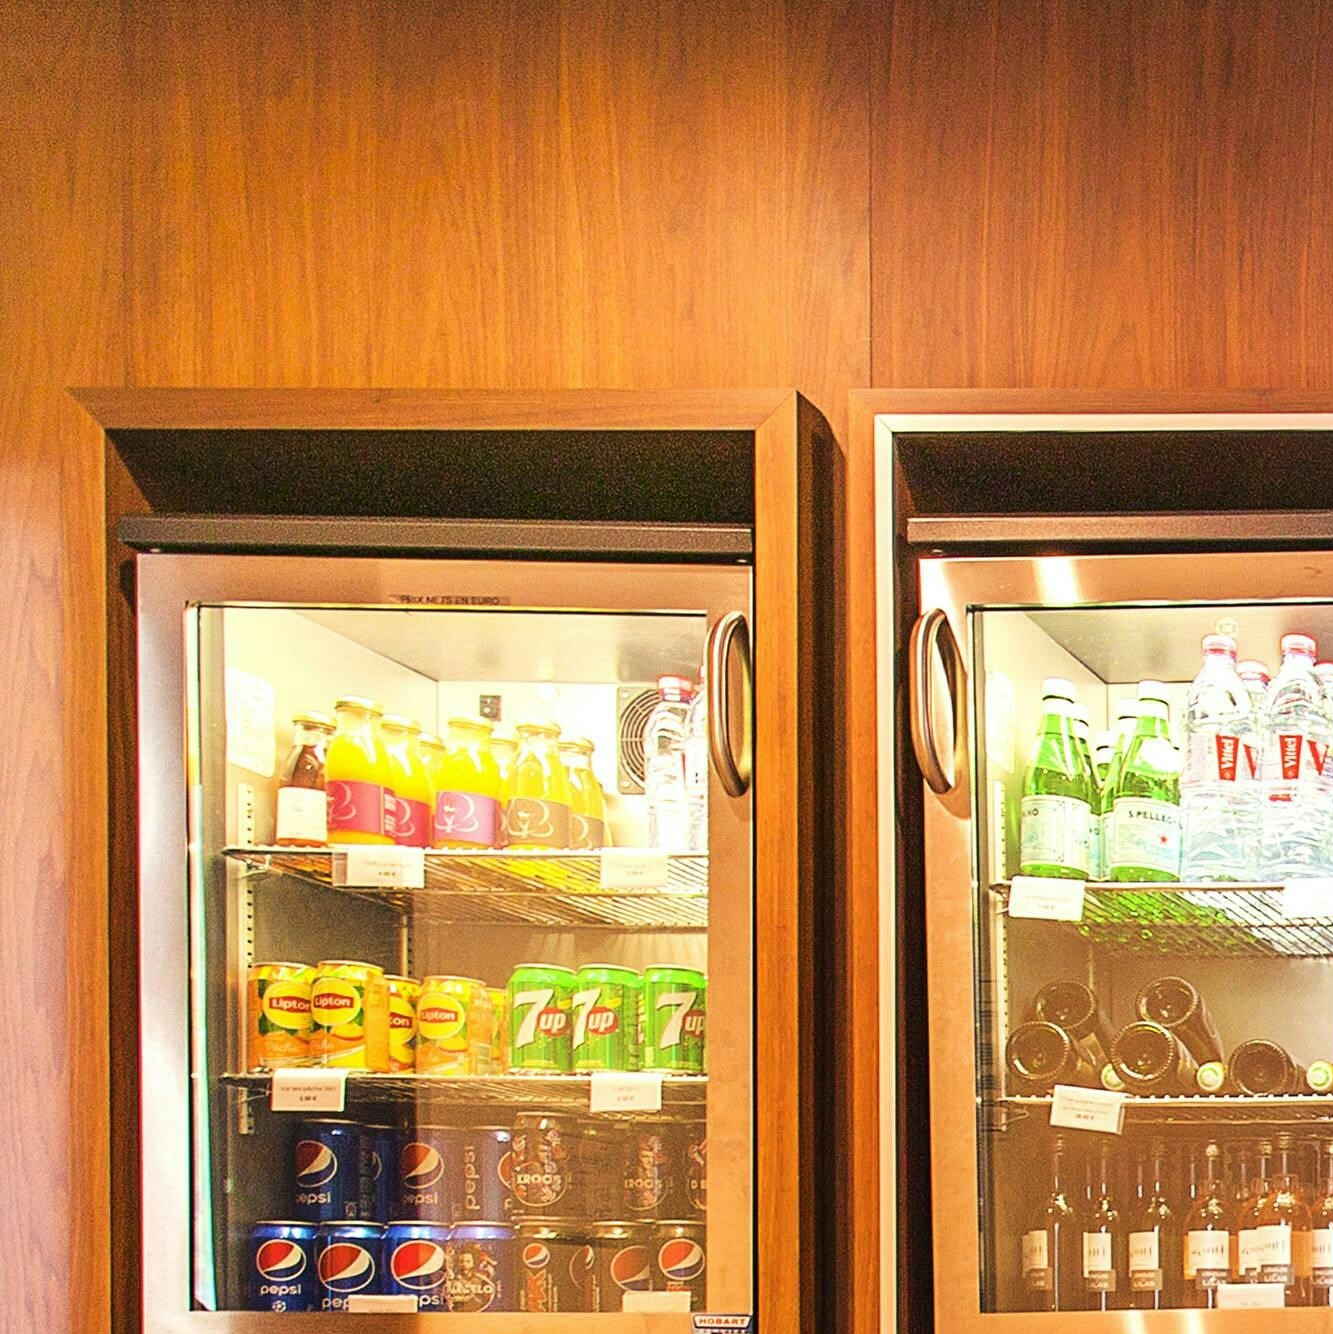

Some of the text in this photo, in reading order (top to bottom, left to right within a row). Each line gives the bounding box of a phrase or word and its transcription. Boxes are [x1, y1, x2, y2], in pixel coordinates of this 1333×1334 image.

[314, 995, 351, 1010] Lipton
[420, 1010, 456, 1023] Lipton
[463, 1146, 480, 1210] pepsi
[260, 1283, 302, 1299] pepsi
[418, 1293, 444, 1309] psi
